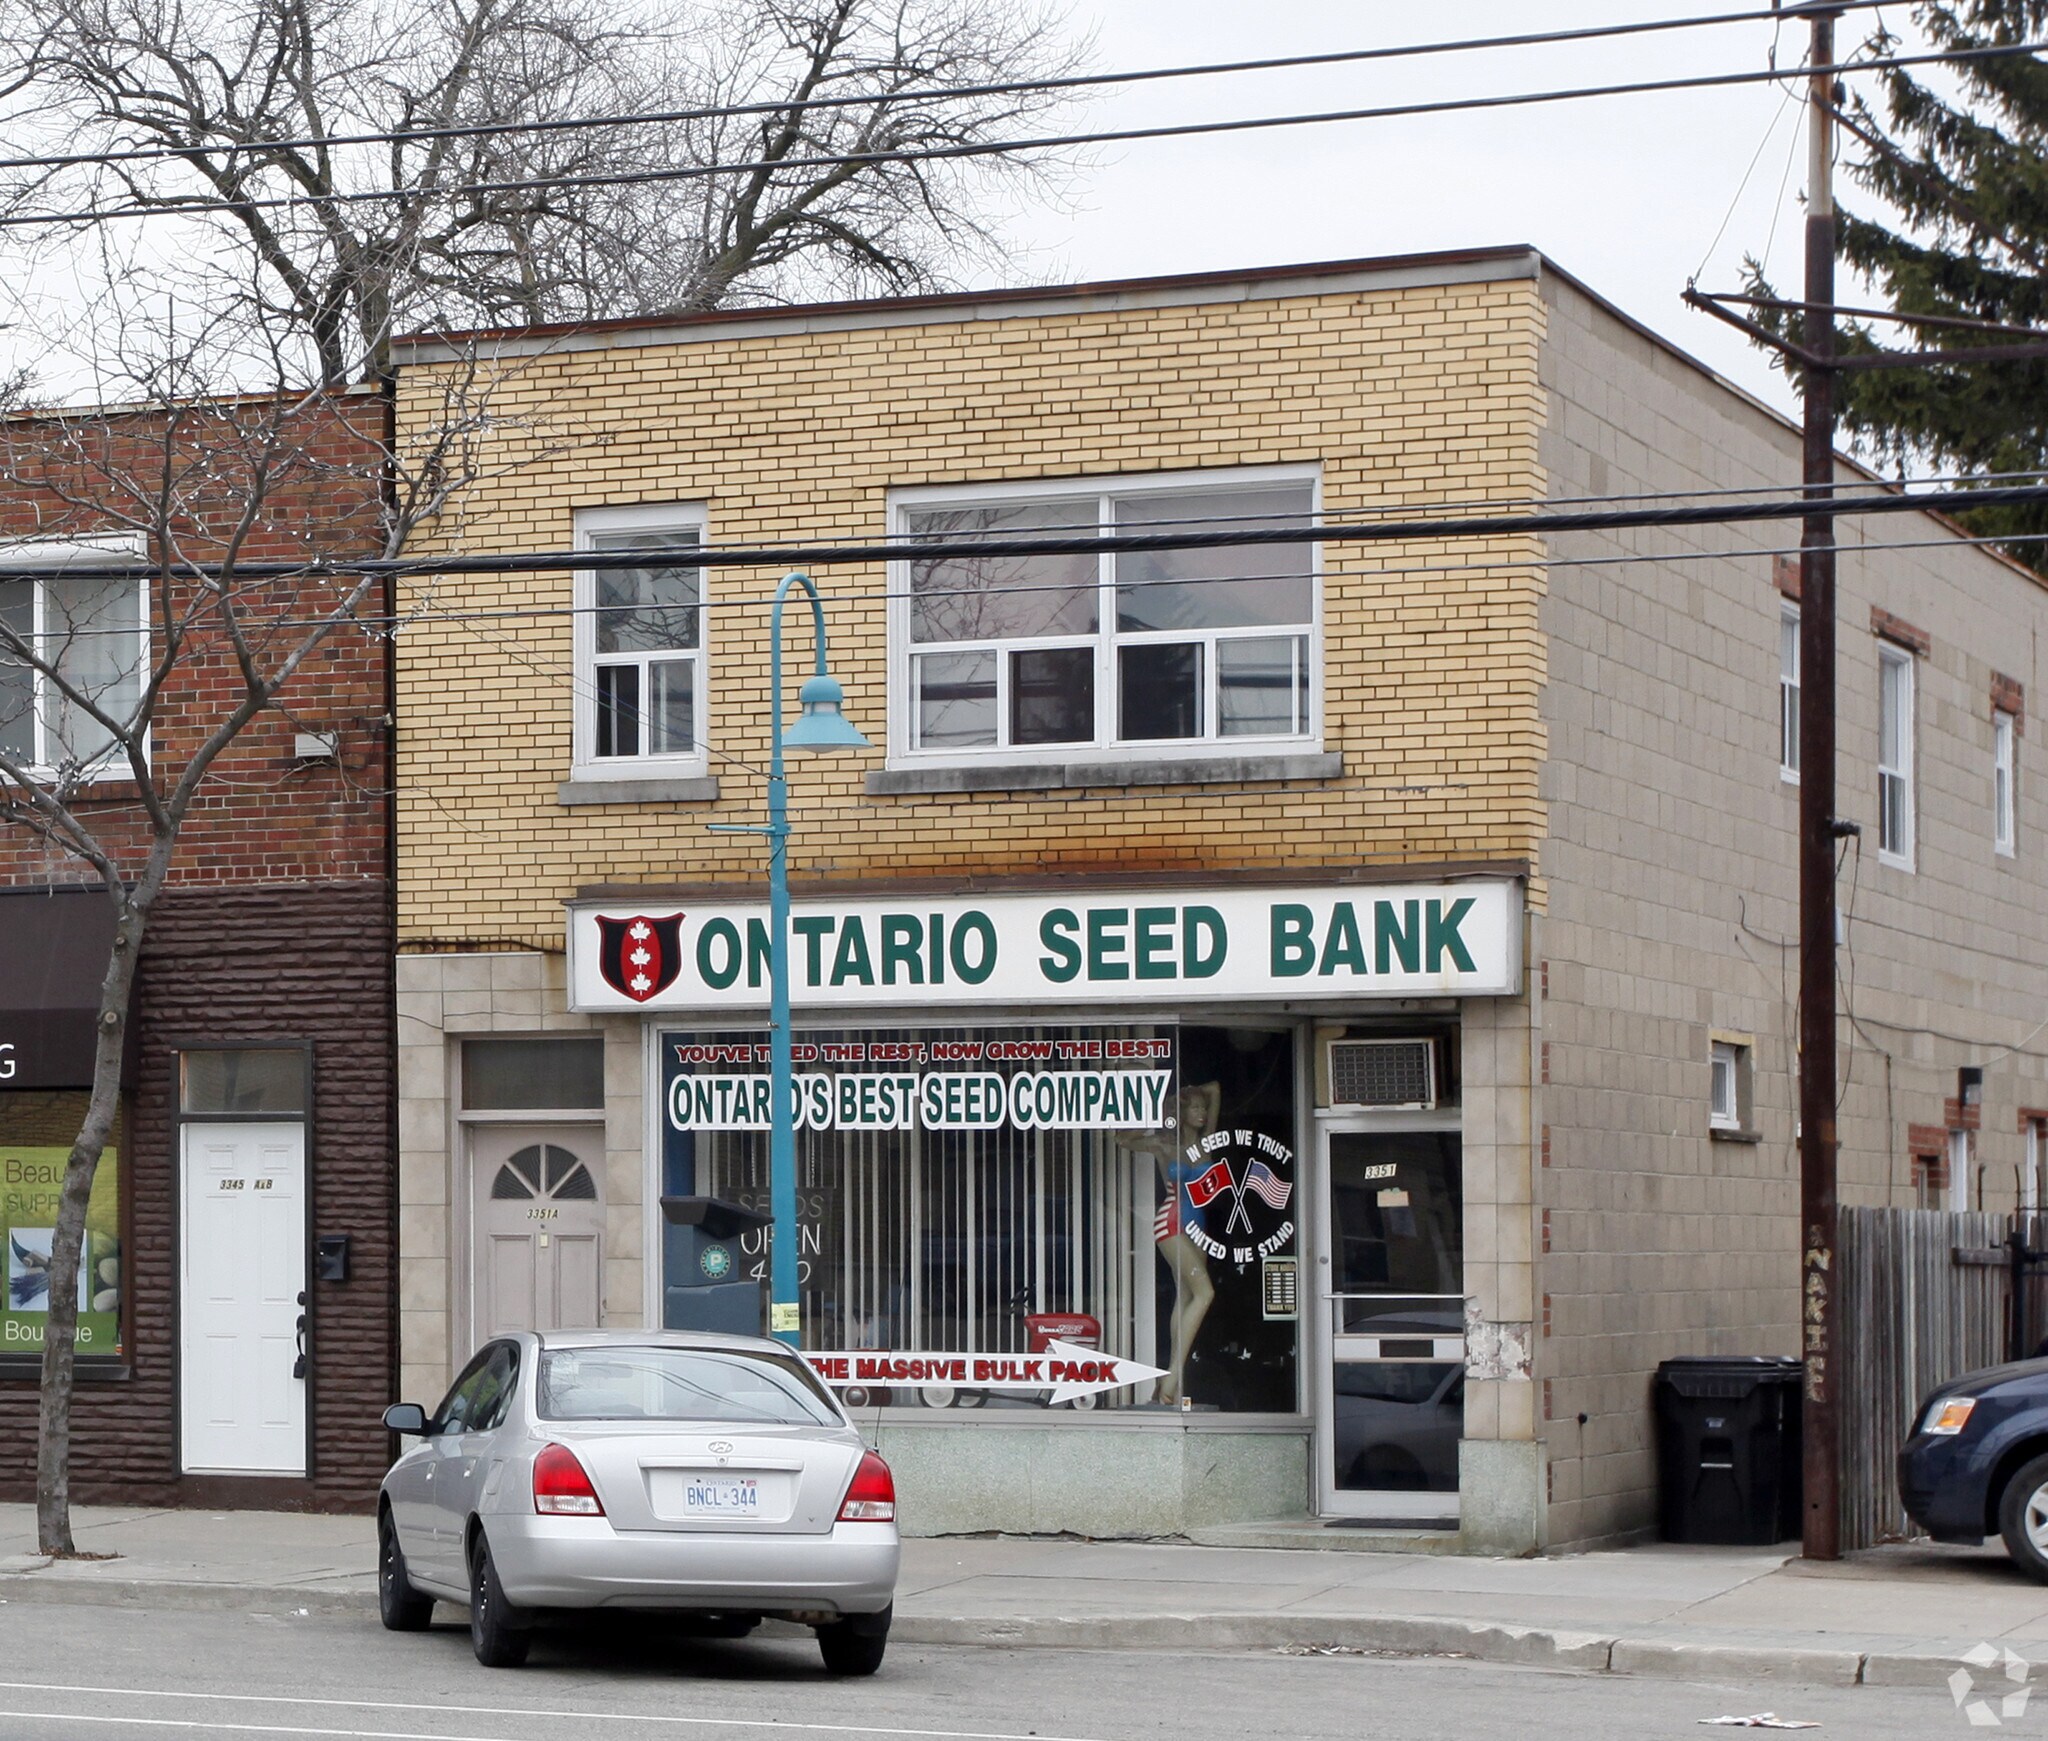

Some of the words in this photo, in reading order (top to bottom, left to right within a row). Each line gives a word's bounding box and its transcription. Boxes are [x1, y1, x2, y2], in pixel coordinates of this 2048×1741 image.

[696, 909, 998, 990] ONTARIO
[1039, 905, 1228, 983] SEED
[1270, 897, 1477, 978] BANK
[675, 1043, 752, 1063] YOU'VE
[754, 1043, 818, 1063] TED
[821, 1043, 865, 1062] THE
[868, 1042, 927, 1064] REST,
[932, 1042, 982, 1061] NOW
[986, 1040, 1054, 1060] GROW
[1056, 1040, 1101, 1059] THE
[1105, 1039, 1170, 1058] BEST!
[672, 1077, 830, 1126] ONTAR'S
[837, 1077, 918, 1124] BEST
[924, 1075, 1003, 1123] SEED
[1012, 1073, 1168, 1123] COMPANY
[1185, 1144, 1202, 1163] IN
[1200, 1130, 1231, 1153] SEED
[1234, 1129, 1253, 1146] WE
[1257, 1133, 1293, 1165] TRUST
[5, 1159, 67, 1184] Beau
[1364, 1163, 1397, 1179] 3351
[220, 1179, 245, 1190] 3345
[527, 1208, 559, 1219] 3351A
[740, 1223, 821, 1255] OPN
[1185, 1220, 1227, 1260] UNITED
[1233, 1247, 1254, 1263] WE
[1257, 1221, 1294, 1258] STAND
[855, 1358, 966, 1381] MASSIVE
[973, 1360, 1042, 1382] BULK
[1048, 1360, 1119, 1383] PACK
[687, 1487, 721, 1505] BNCL
[731, 1488, 757, 1506] 344
